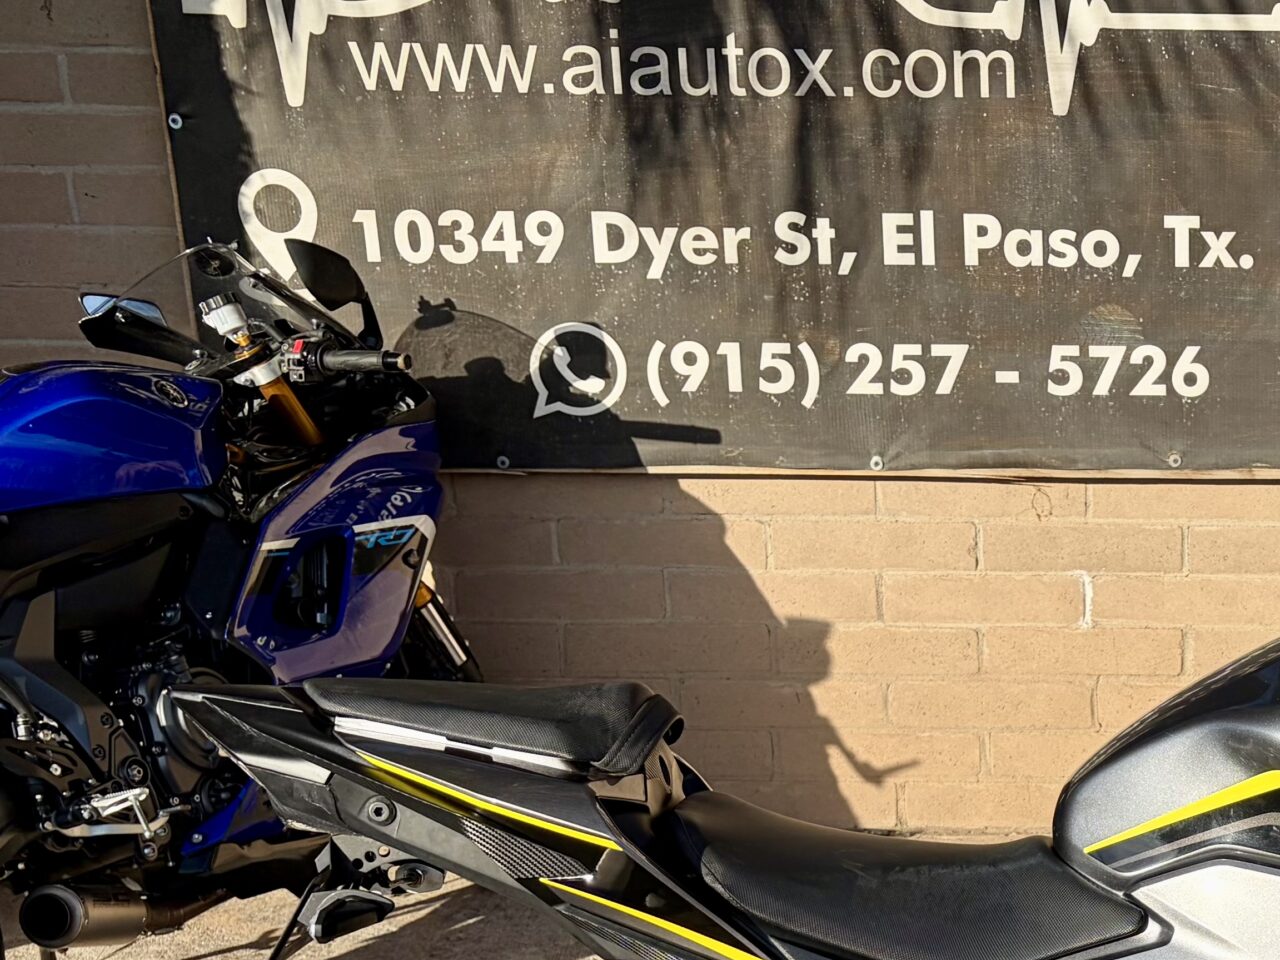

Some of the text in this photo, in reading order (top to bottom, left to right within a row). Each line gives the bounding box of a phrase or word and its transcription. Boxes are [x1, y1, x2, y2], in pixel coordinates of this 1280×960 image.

[347, 28, 1016, 99] www.aiautox.com
[351, 208, 566, 265] 10349
[590, 210, 751, 285] Dyer
[774, 211, 858, 276] St,
[881, 209, 936, 266] El
[962, 213, 1142, 278] Paso,
[1163, 214, 1254, 270] Tx.
[646, 339, 1210, 410] (915) 257 - 5726
